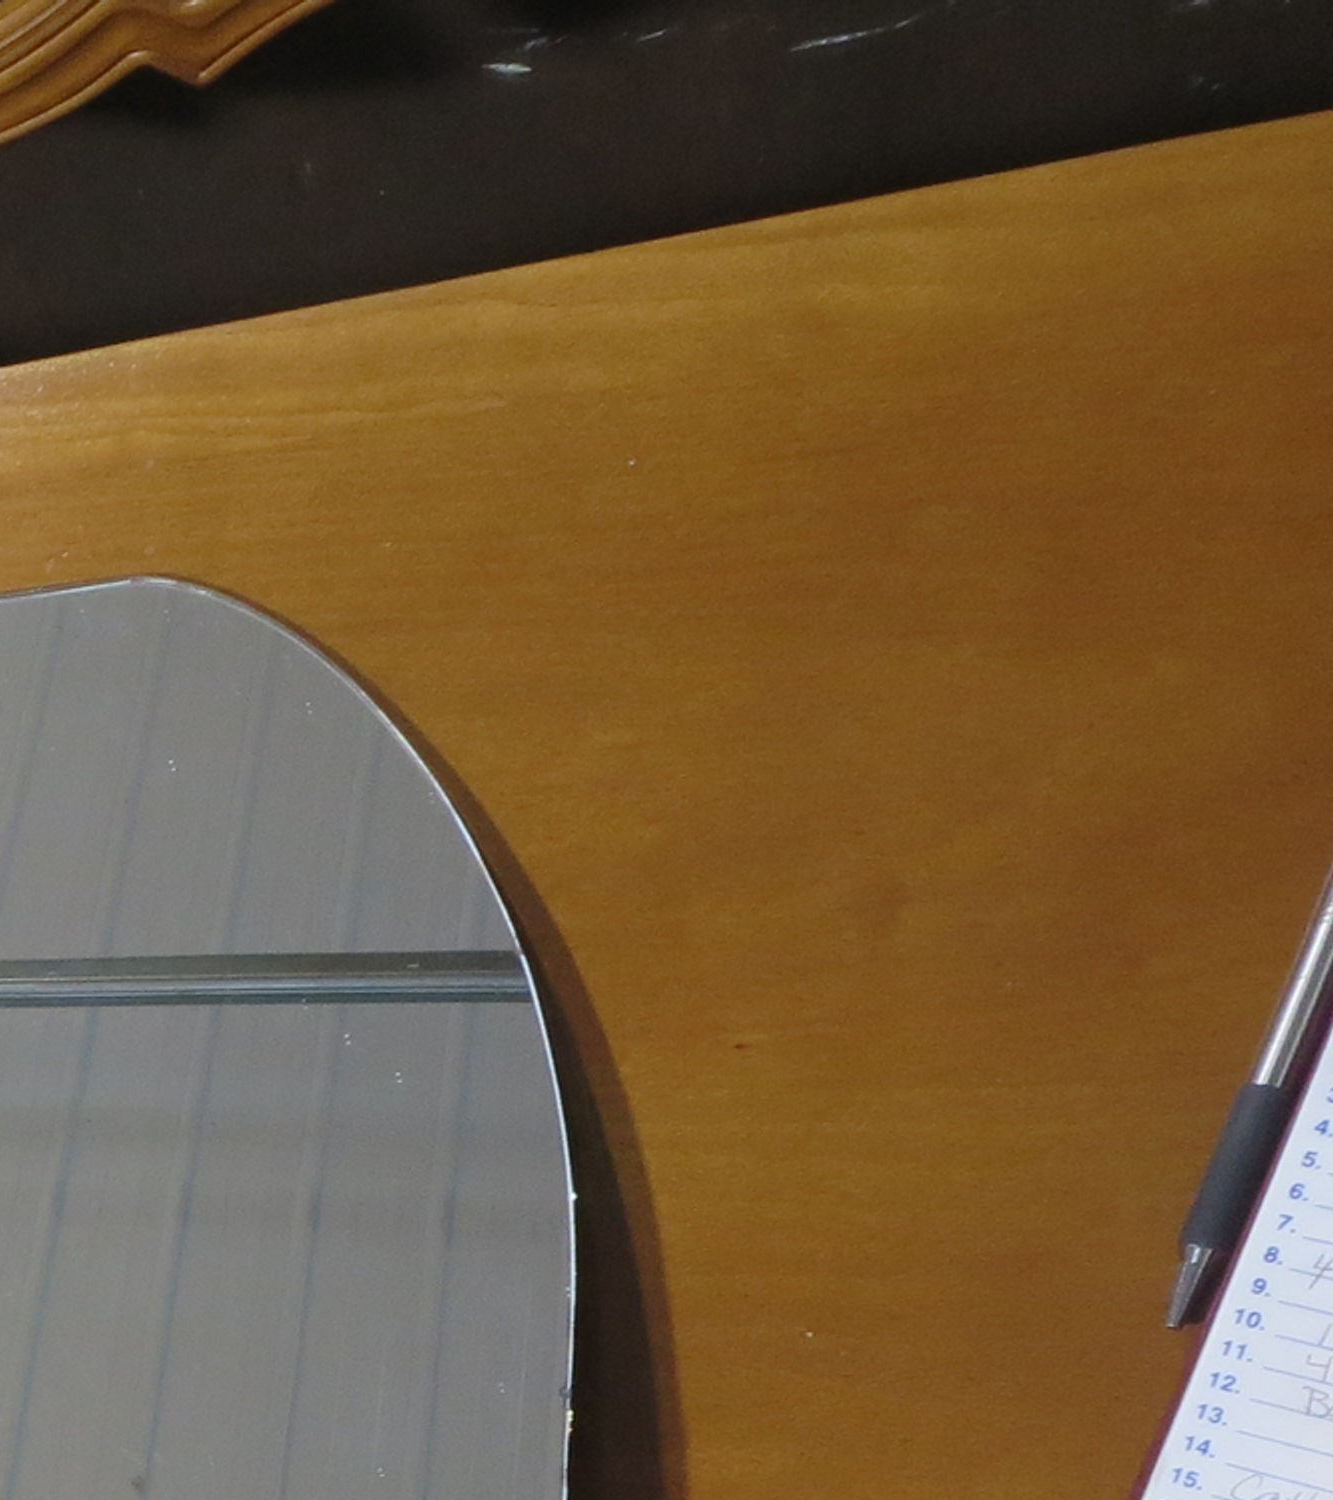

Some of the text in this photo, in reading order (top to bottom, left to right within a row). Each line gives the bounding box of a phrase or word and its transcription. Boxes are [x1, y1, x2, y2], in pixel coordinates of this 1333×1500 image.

[1301, 1151, 1322, 1170] 5.
[1289, 1183, 1309, 1201] 6.
[1277, 1214, 1296, 1233] 7.
[1263, 1246, 1283, 1265] 8.
[1251, 1278, 1271, 1298] 9.
[1234, 1308, 1265, 1331] 10.
[1222, 1340, 1253, 1362] 11.
[1209, 1371, 1240, 1394] 12.
[1196, 1403, 1228, 1427] 13.
[1185, 1436, 1215, 1458] 14.
[1172, 1467, 1202, 1491] 15.
